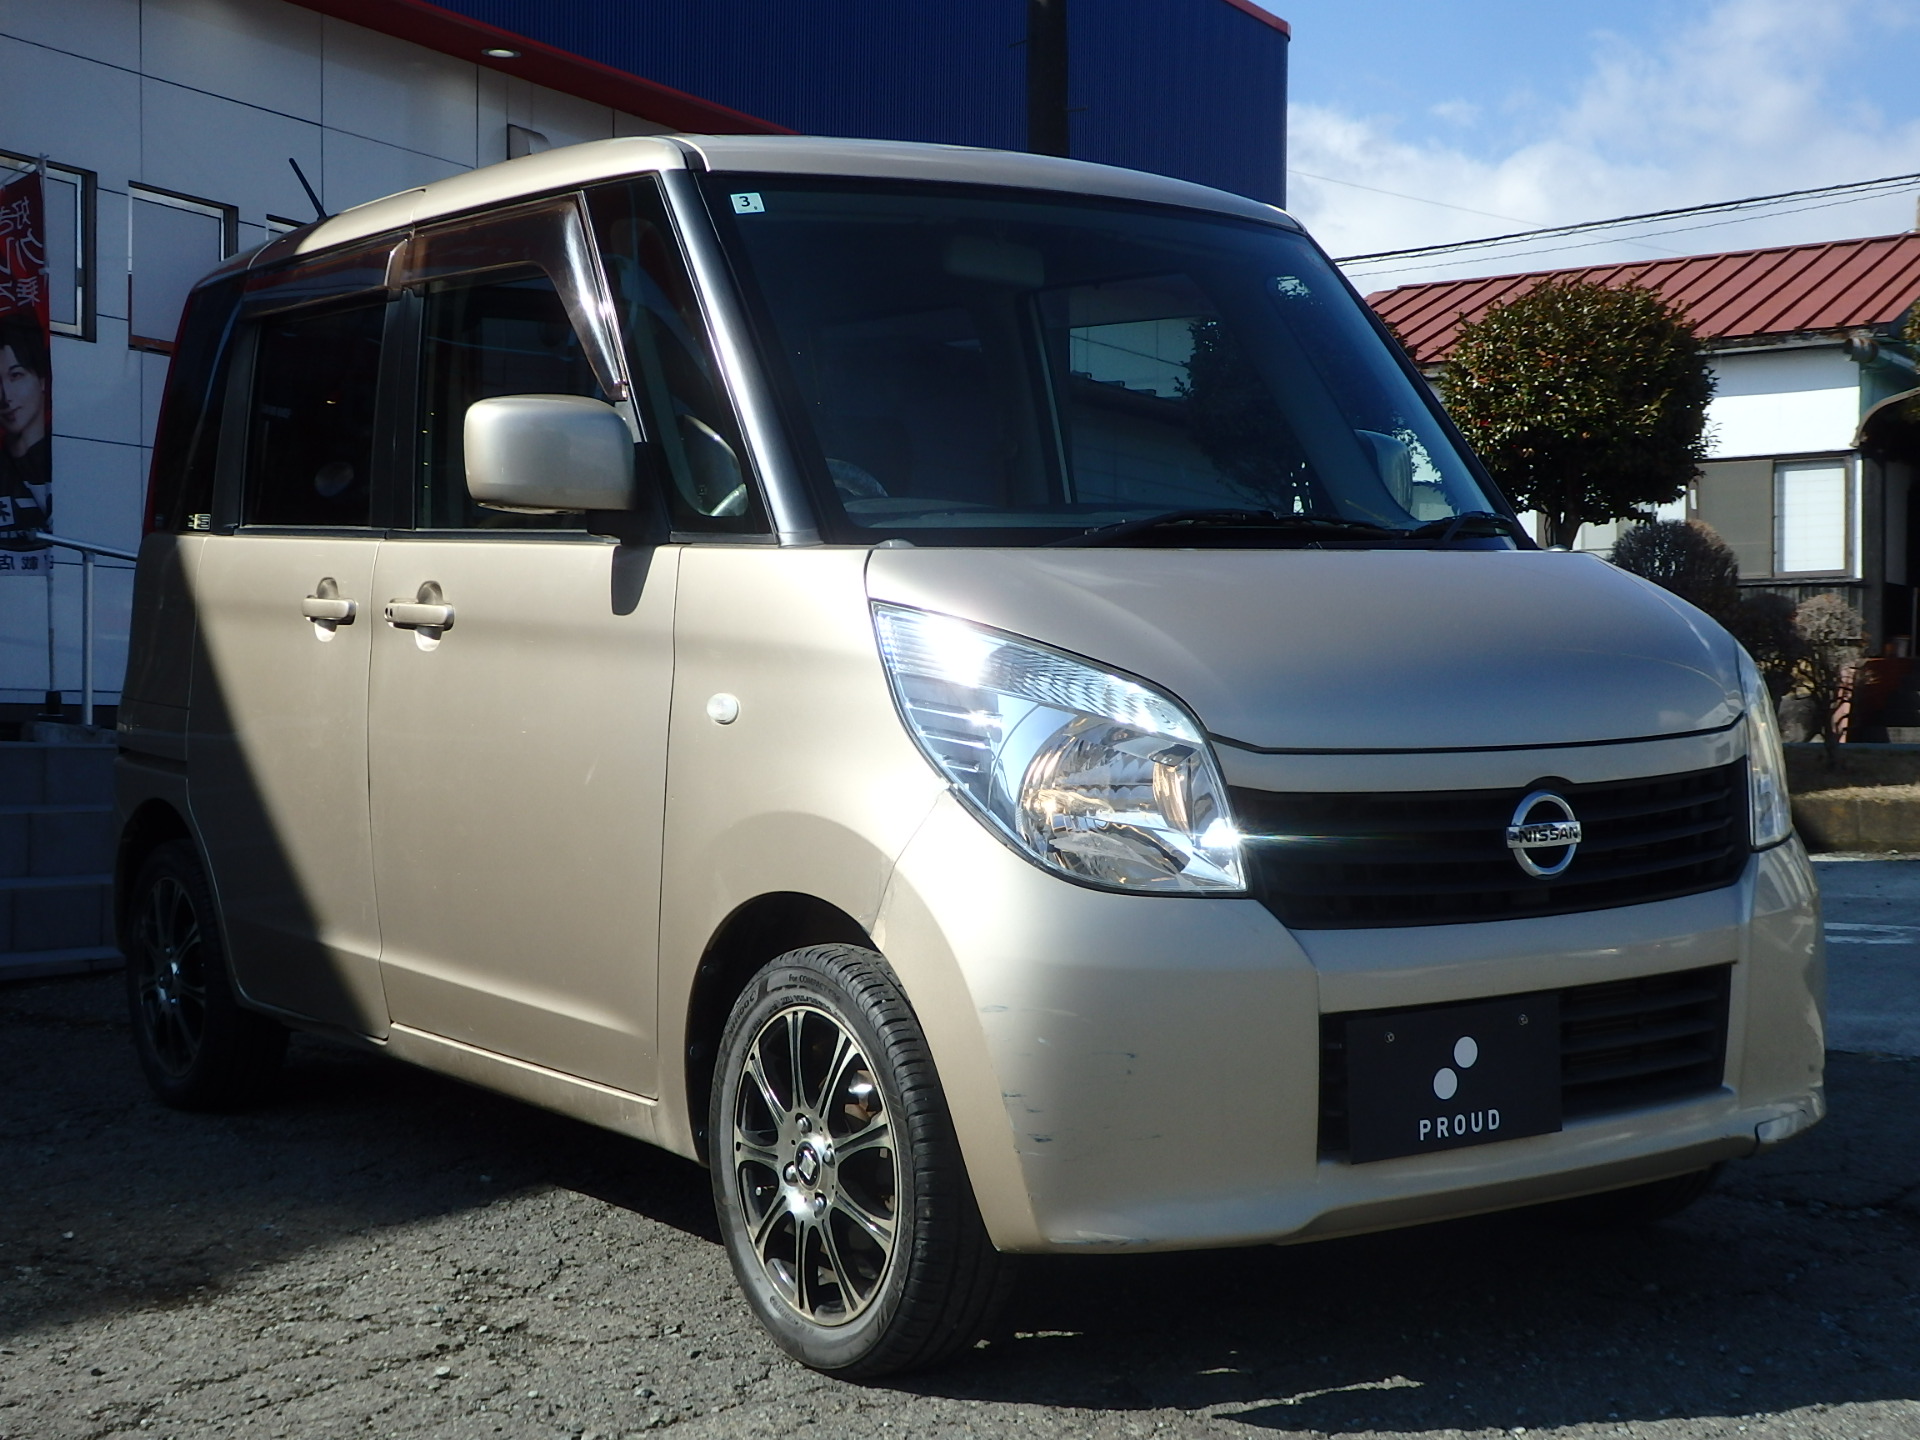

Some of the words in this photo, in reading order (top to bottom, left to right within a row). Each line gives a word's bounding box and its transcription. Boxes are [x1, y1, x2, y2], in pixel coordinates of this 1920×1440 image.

[738, 195, 751, 207] 3
[1518, 826, 1580, 844] NISSAN
[1419, 1108, 1500, 1141] PROUD
